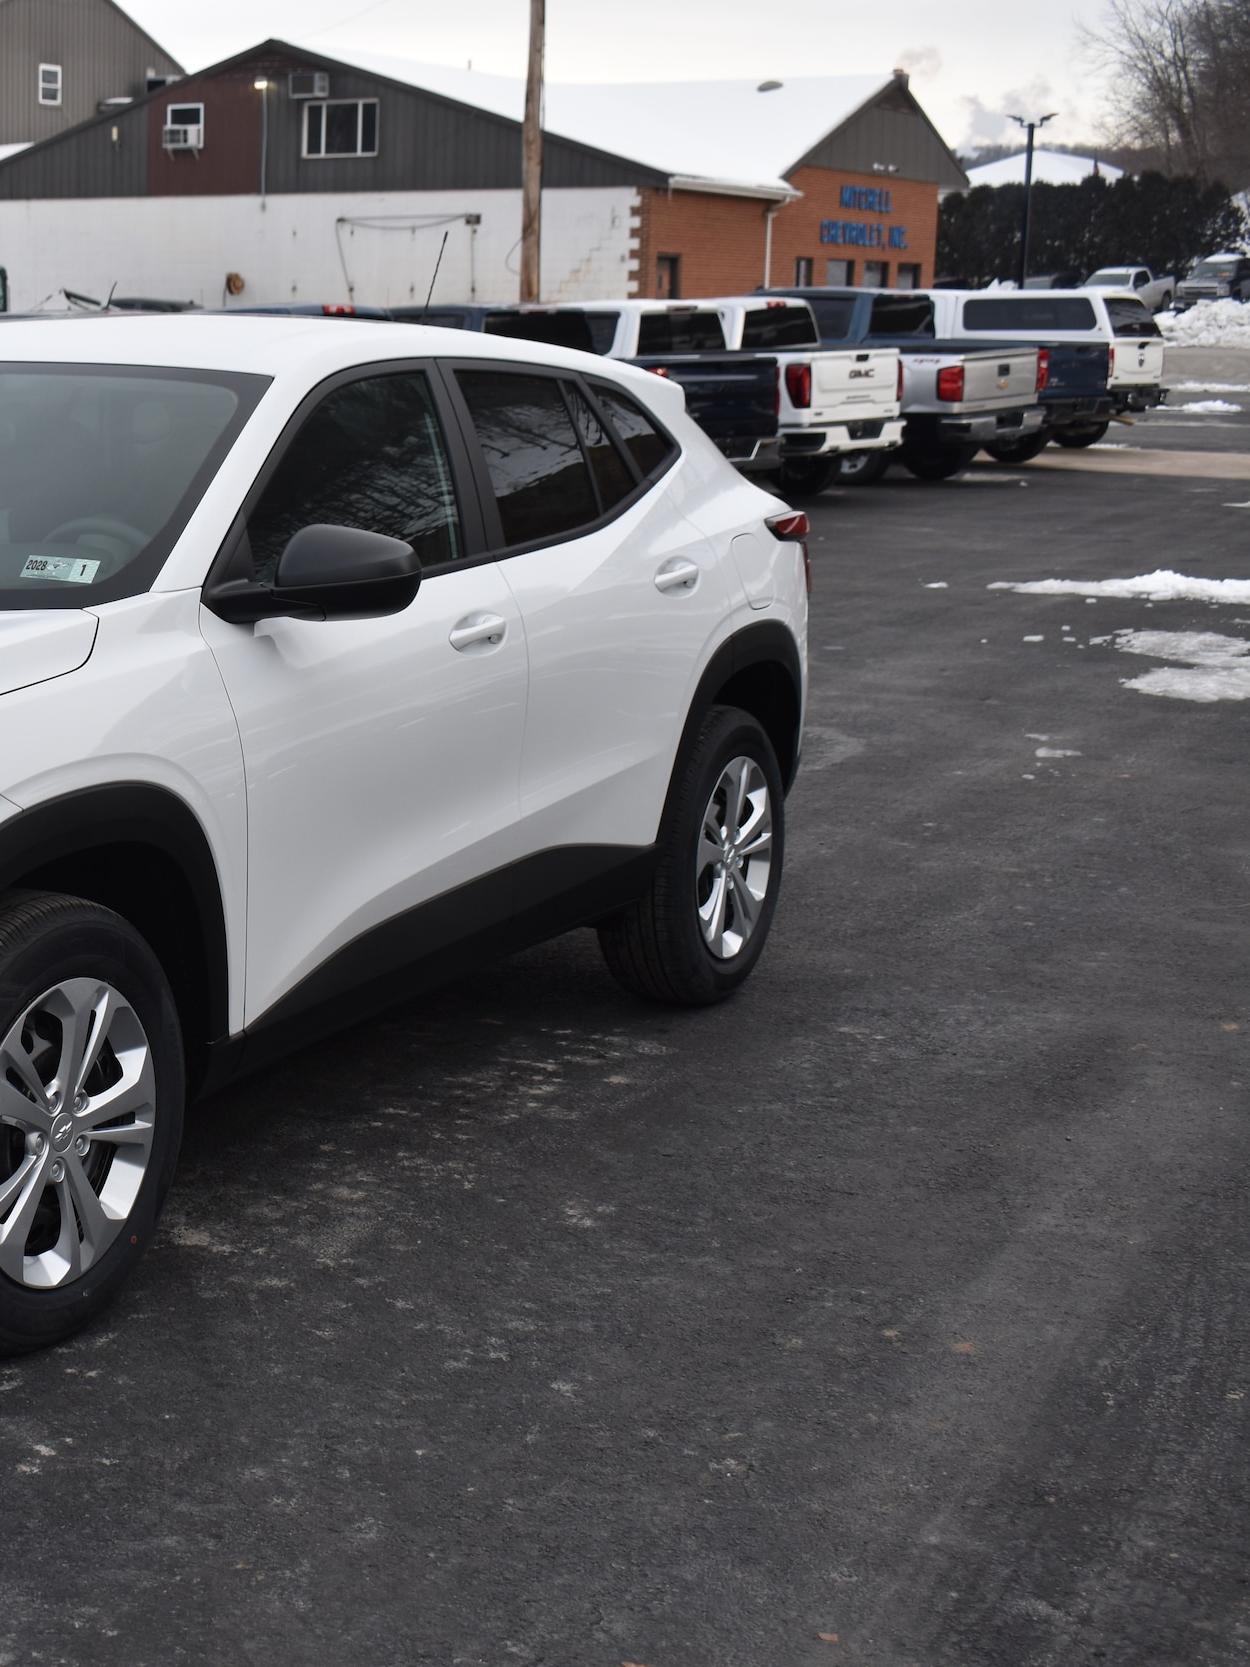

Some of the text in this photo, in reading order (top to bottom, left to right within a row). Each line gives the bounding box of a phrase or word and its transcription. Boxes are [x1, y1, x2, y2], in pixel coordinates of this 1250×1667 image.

[848, 368, 875, 379] GMC
[25, 559, 48, 571] 2028
[79, 564, 87, 577] 1
